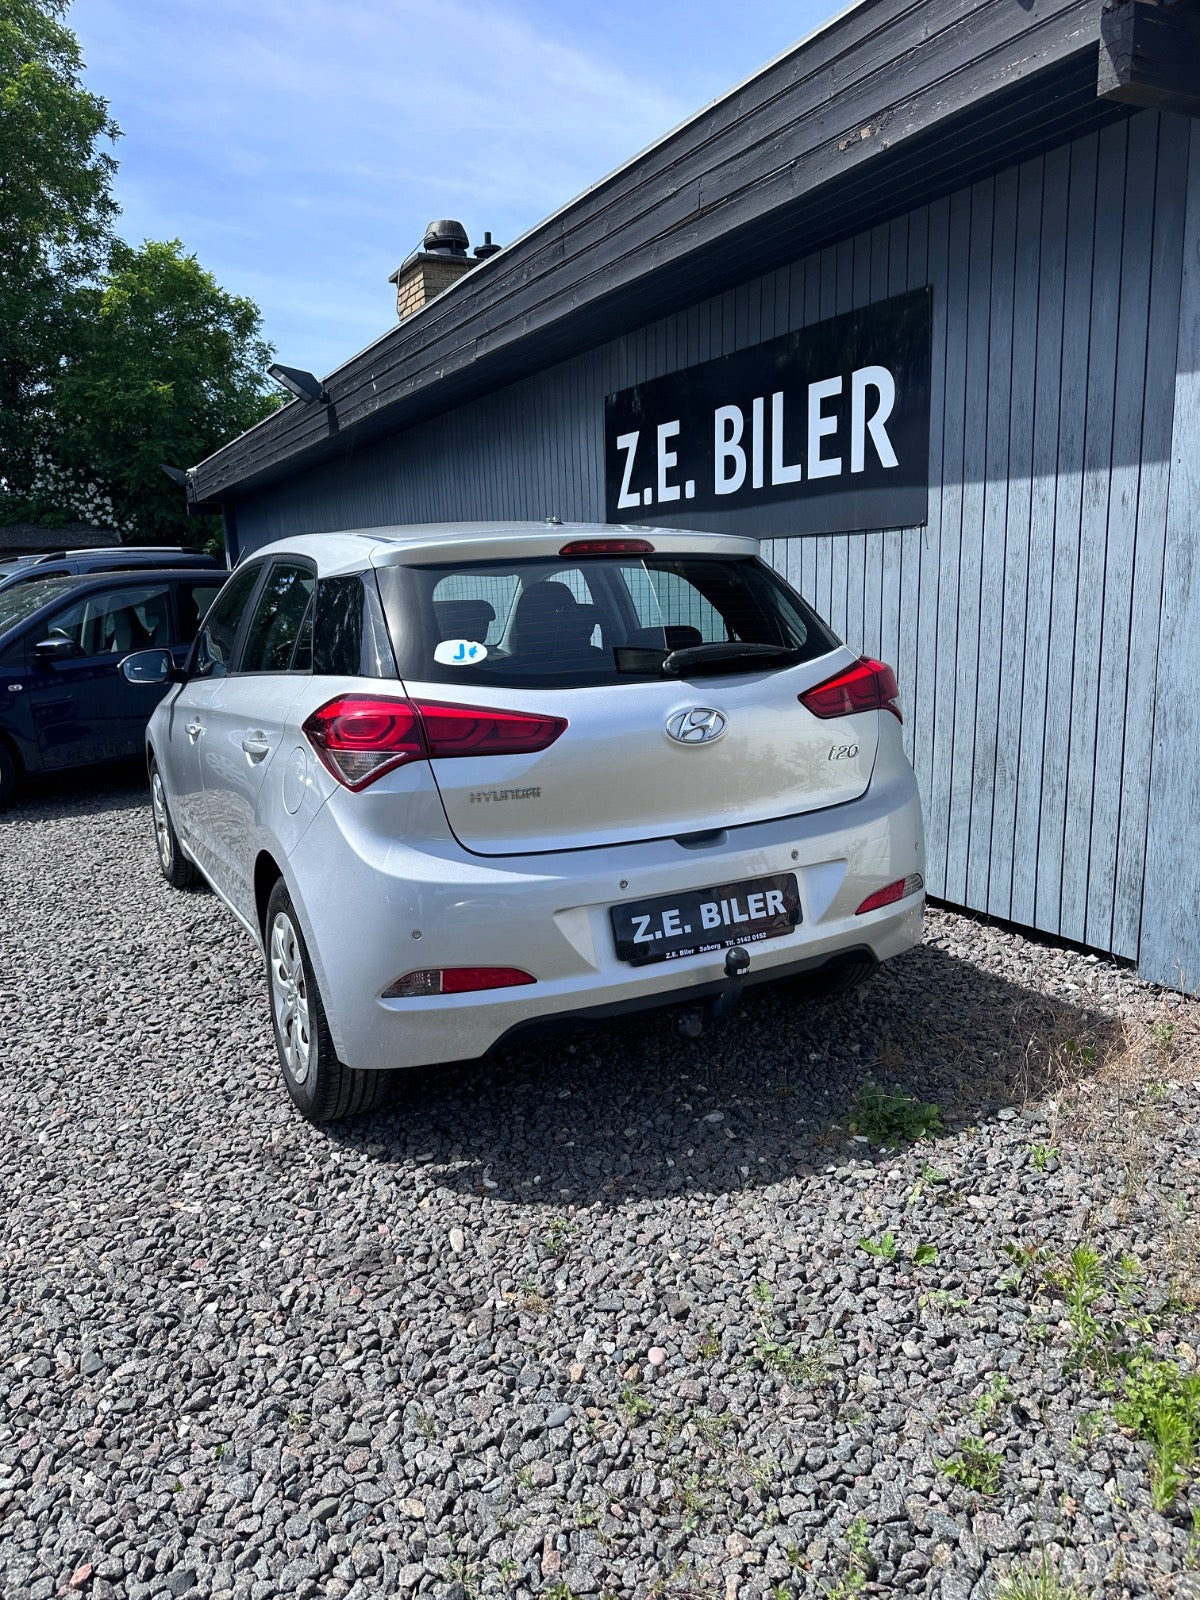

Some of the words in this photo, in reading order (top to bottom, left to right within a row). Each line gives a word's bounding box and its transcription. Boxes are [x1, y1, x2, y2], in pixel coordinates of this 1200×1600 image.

[616, 419, 695, 509] Z.E.
[714, 365, 900, 495] BILER
[469, 786, 541, 803] HYUNDAI
[631, 909, 691, 944] Z.E.
[700, 889, 787, 930] BILER
[679, 948, 695, 957] Biler
[736, 935, 752, 944] 3142
